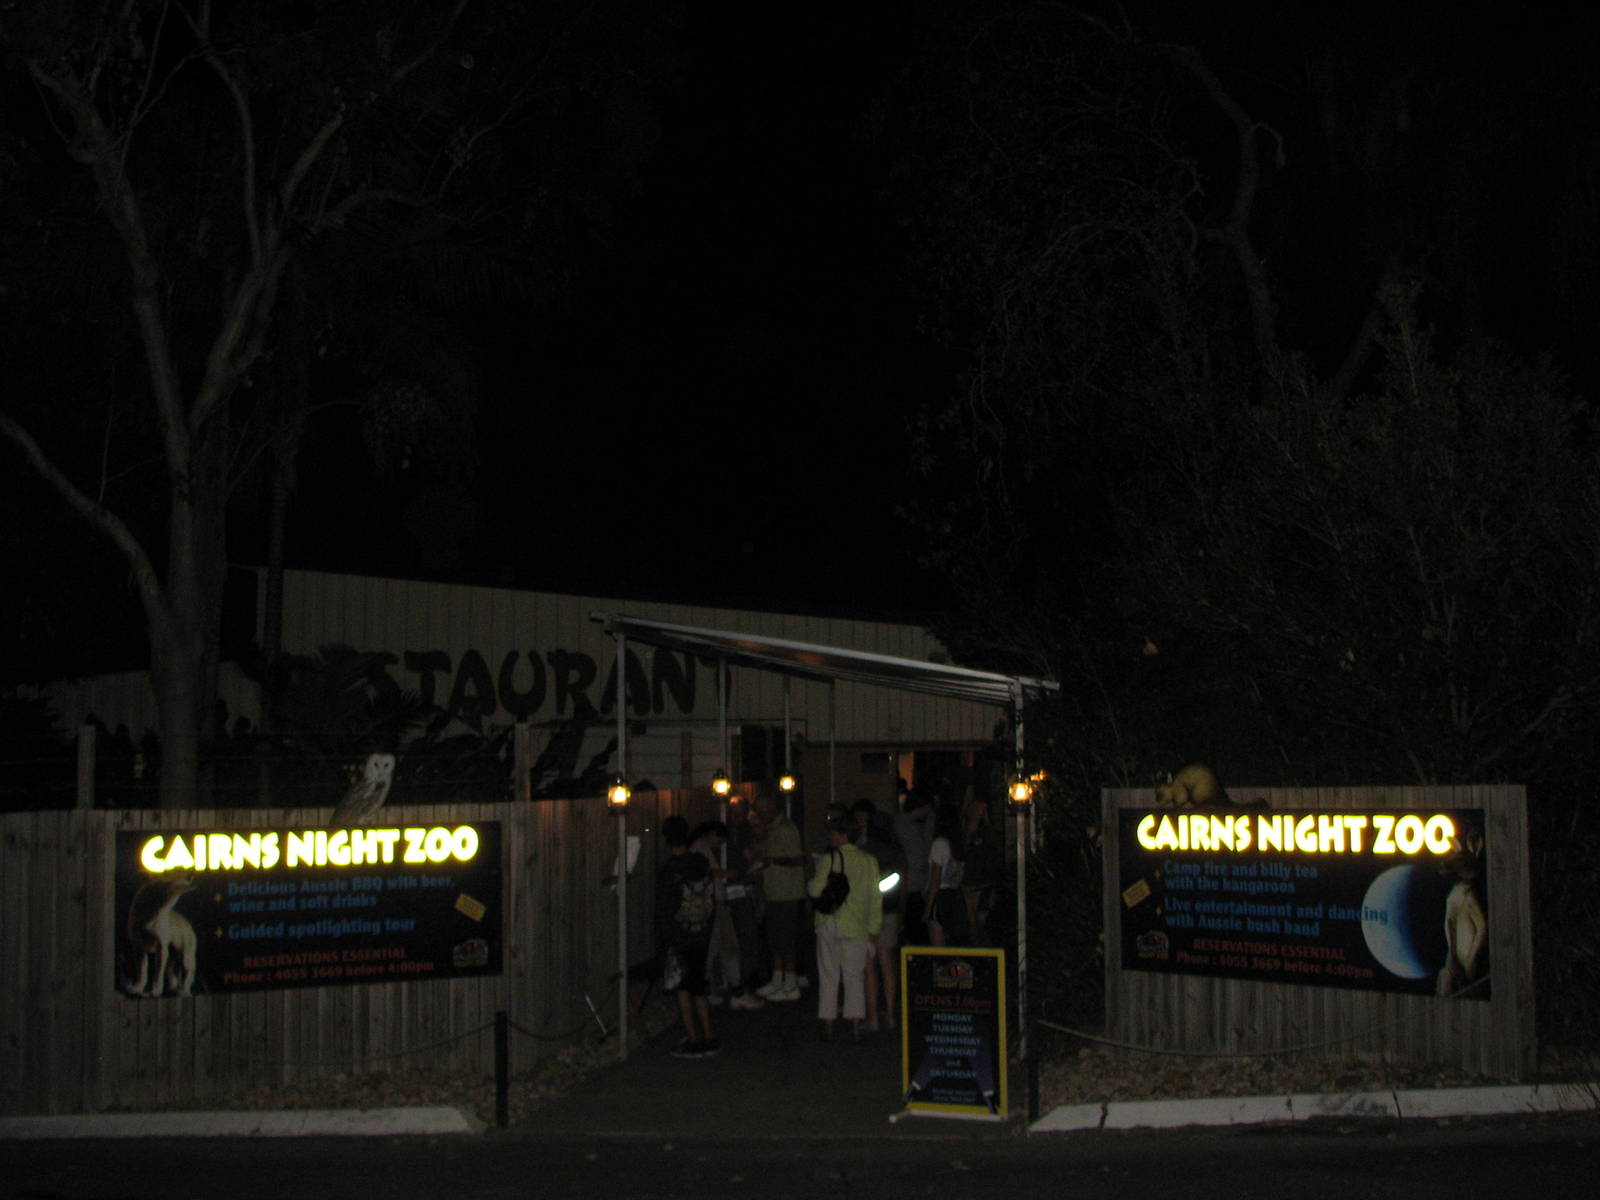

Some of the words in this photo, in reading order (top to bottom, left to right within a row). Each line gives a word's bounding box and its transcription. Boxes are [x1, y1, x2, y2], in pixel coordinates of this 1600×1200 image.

[1137, 814, 1252, 852] CAIRNS
[1257, 814, 1367, 854] NIGHT
[1371, 814, 1456, 855] ZOO
[141, 833, 280, 873] CAIRNS
[286, 829, 400, 868] NIGHT
[402, 825, 479, 864] ZOO
[1164, 860, 1200, 878] Camp
[1204, 862, 1228, 876] fire
[1232, 863, 1257, 878] and
[1260, 862, 1291, 881] billy
[1295, 865, 1318, 879] tea
[228, 880, 296, 896] Delicious
[300, 878, 348, 893] Aussie
[351, 876, 383, 892] BBQ
[387, 875, 417, 889] with
[1164, 876, 1195, 890] with
[1198, 877, 1219, 891] the
[1222, 878, 1296, 896] kangaroos
[228, 898, 264, 912] wine
[268, 896, 295, 911] and
[299, 894, 328, 910] soft
[332, 893, 377, 908] drinks
[1164, 896, 1192, 911] Live
[1194, 899, 1293, 918] entertainment
[1296, 904, 1324, 919] and
[1328, 904, 1388, 924] dancing
[228, 923, 285, 940] Guided
[288, 920, 381, 939] spotlighting
[384, 918, 416, 932] tour
[1165, 913, 1194, 927] with
[1199, 915, 1242, 931] Aussie
[1247, 917, 1280, 933] bush
[1284, 920, 1320, 937] band
[243, 951, 339, 968] RESERVATIONS
[342, 947, 408, 962] ESSENTIAL
[1193, 938, 1278, 956] RESERVATIONS
[1280, 942, 1345, 960] ESSENTIAL
[1176, 951, 1209, 965] Phone
[1284, 959, 1322, 974] before
[223, 970, 265, 984] Phone
[345, 964, 384, 977] before
[932, 1013, 972, 1022] MONDAY
[932, 1023, 973, 1034] TUESDAY
[925, 1034, 981, 1046] WEDNESDAY
[929, 1046, 977, 1056] THURSDAY
[929, 1068, 977, 1079] SATURDAY
